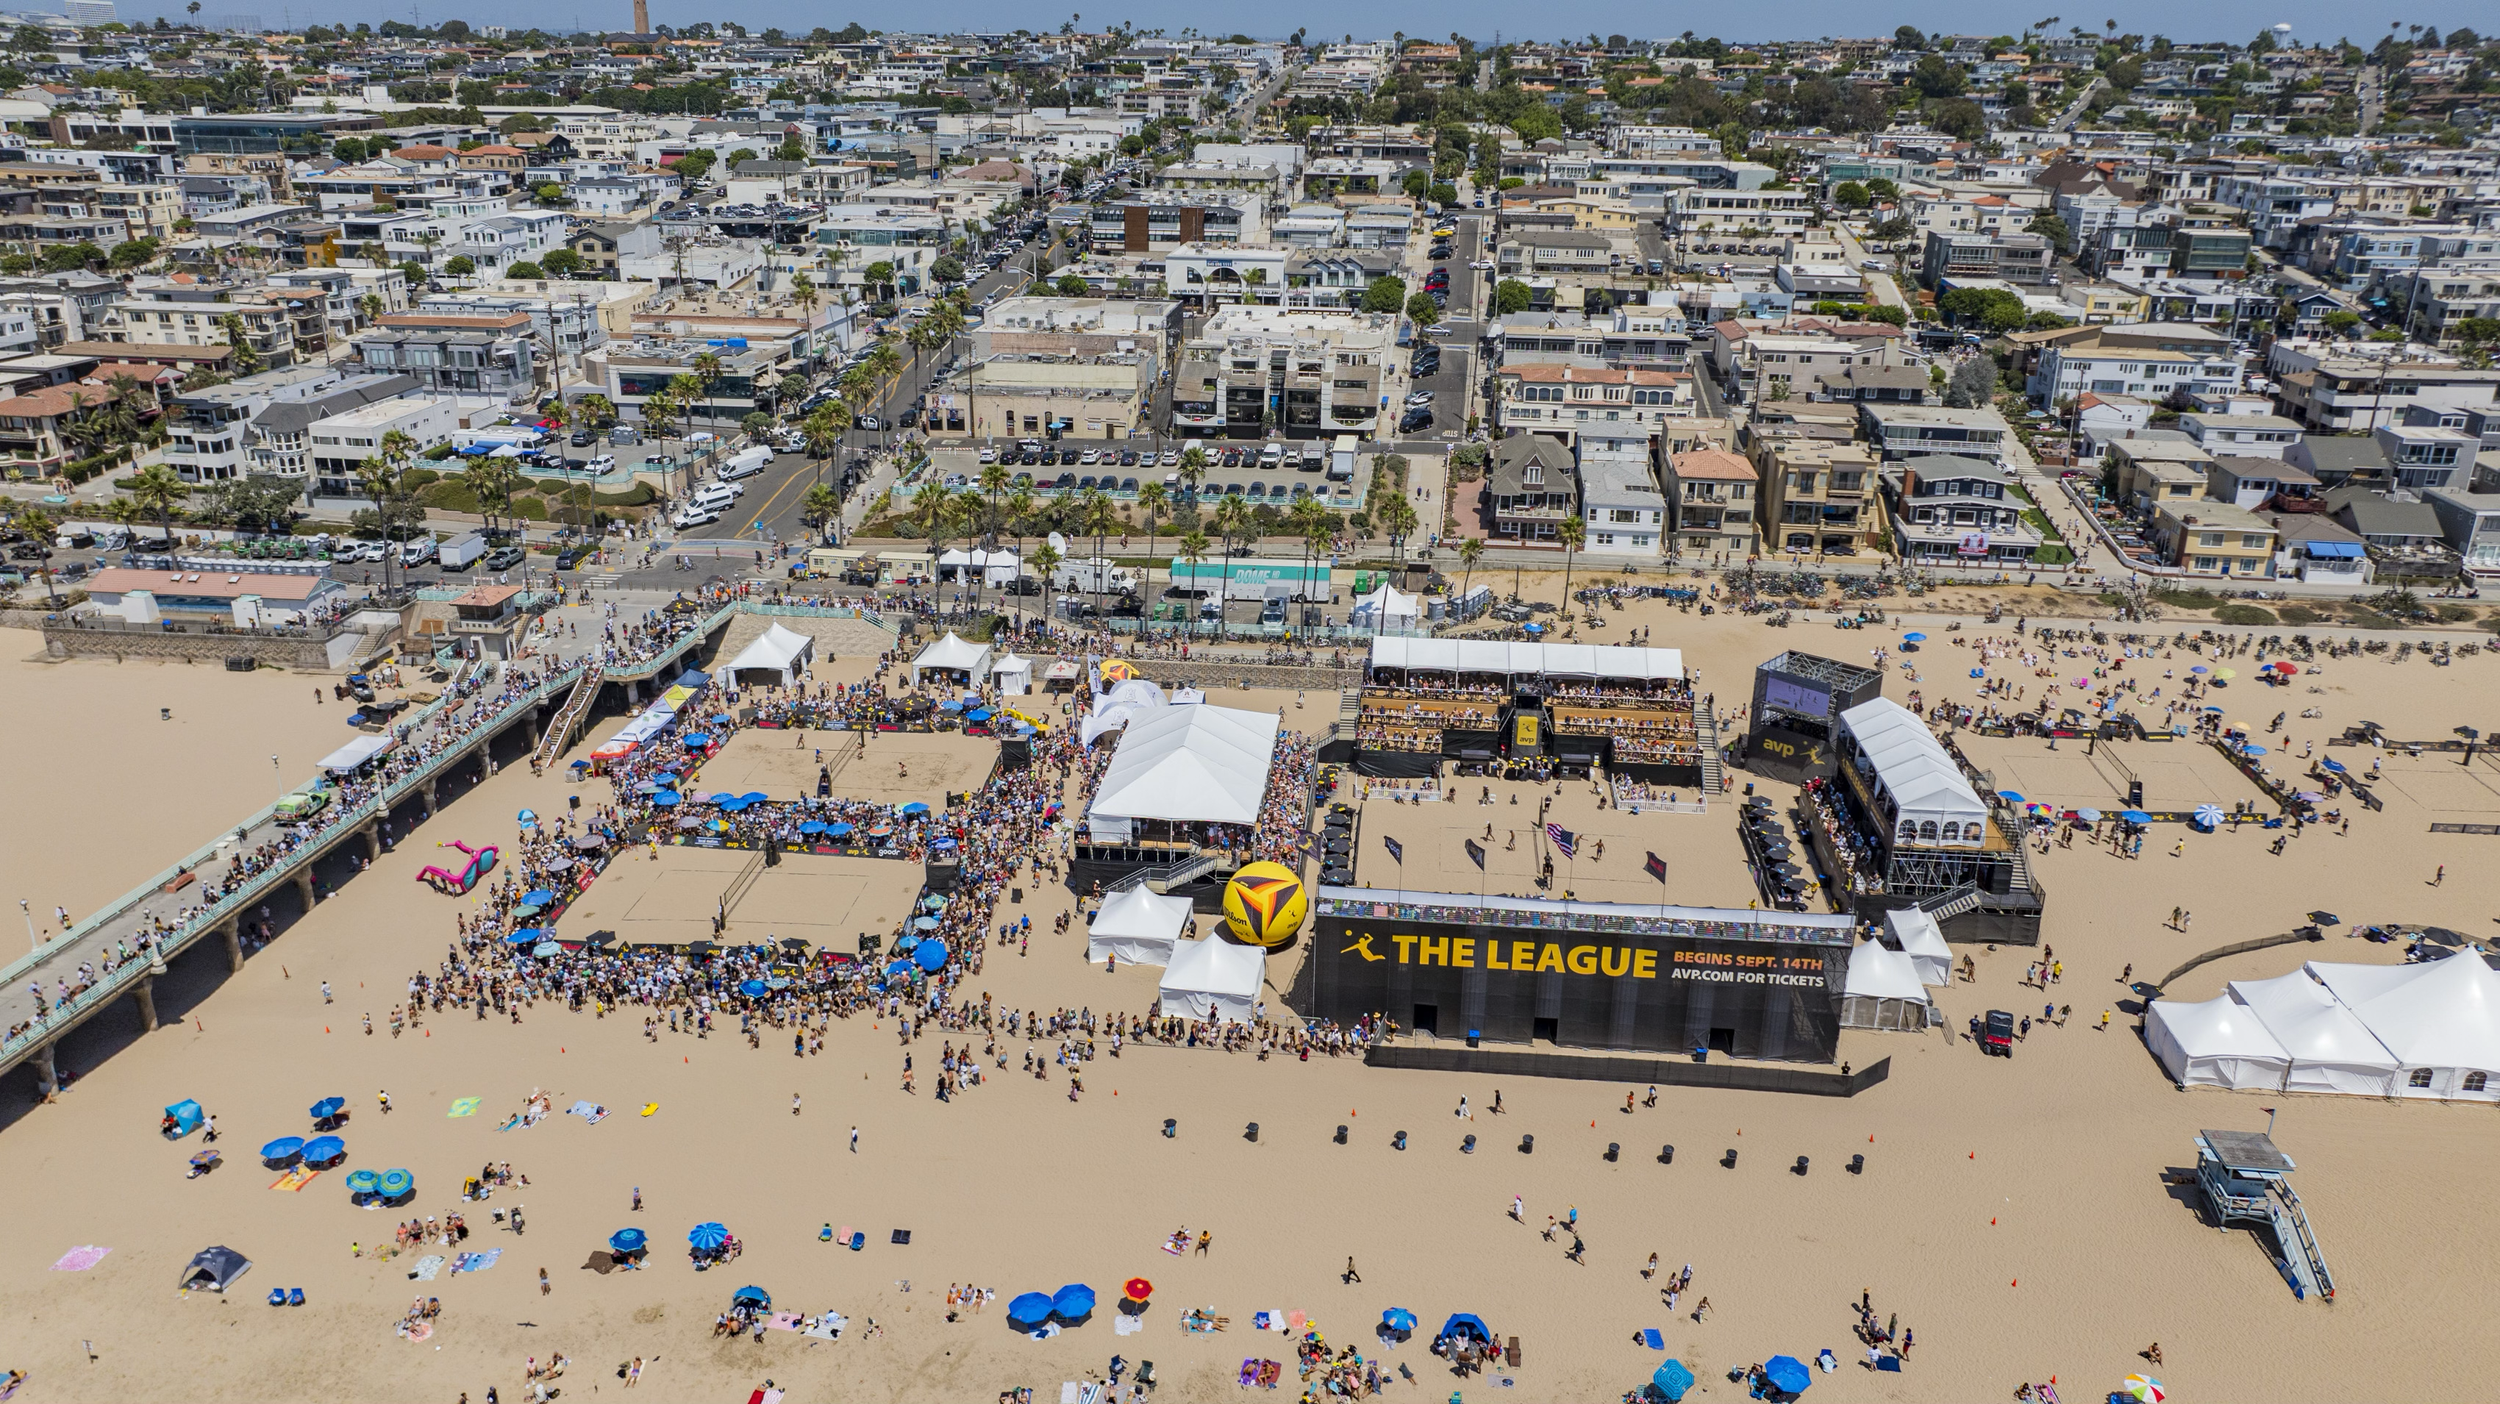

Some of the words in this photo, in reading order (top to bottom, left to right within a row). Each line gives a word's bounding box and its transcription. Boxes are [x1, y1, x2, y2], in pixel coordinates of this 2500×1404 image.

[1235, 569, 1270, 584] DOME
[1763, 738, 1794, 758] avp
[1224, 906, 1247, 926] Wilson
[1392, 935, 1475, 968] THE
[1487, 939, 1658, 978] LEAGUE
[1674, 951, 1733, 965] BEGINS
[1736, 955, 1777, 968] SEPT.
[1782, 958, 1823, 970] 14TH
[1671, 968, 1734, 982] AVP.COM
[1736, 972, 1765, 984] FOR
[1767, 974, 1824, 987] TICKETS
